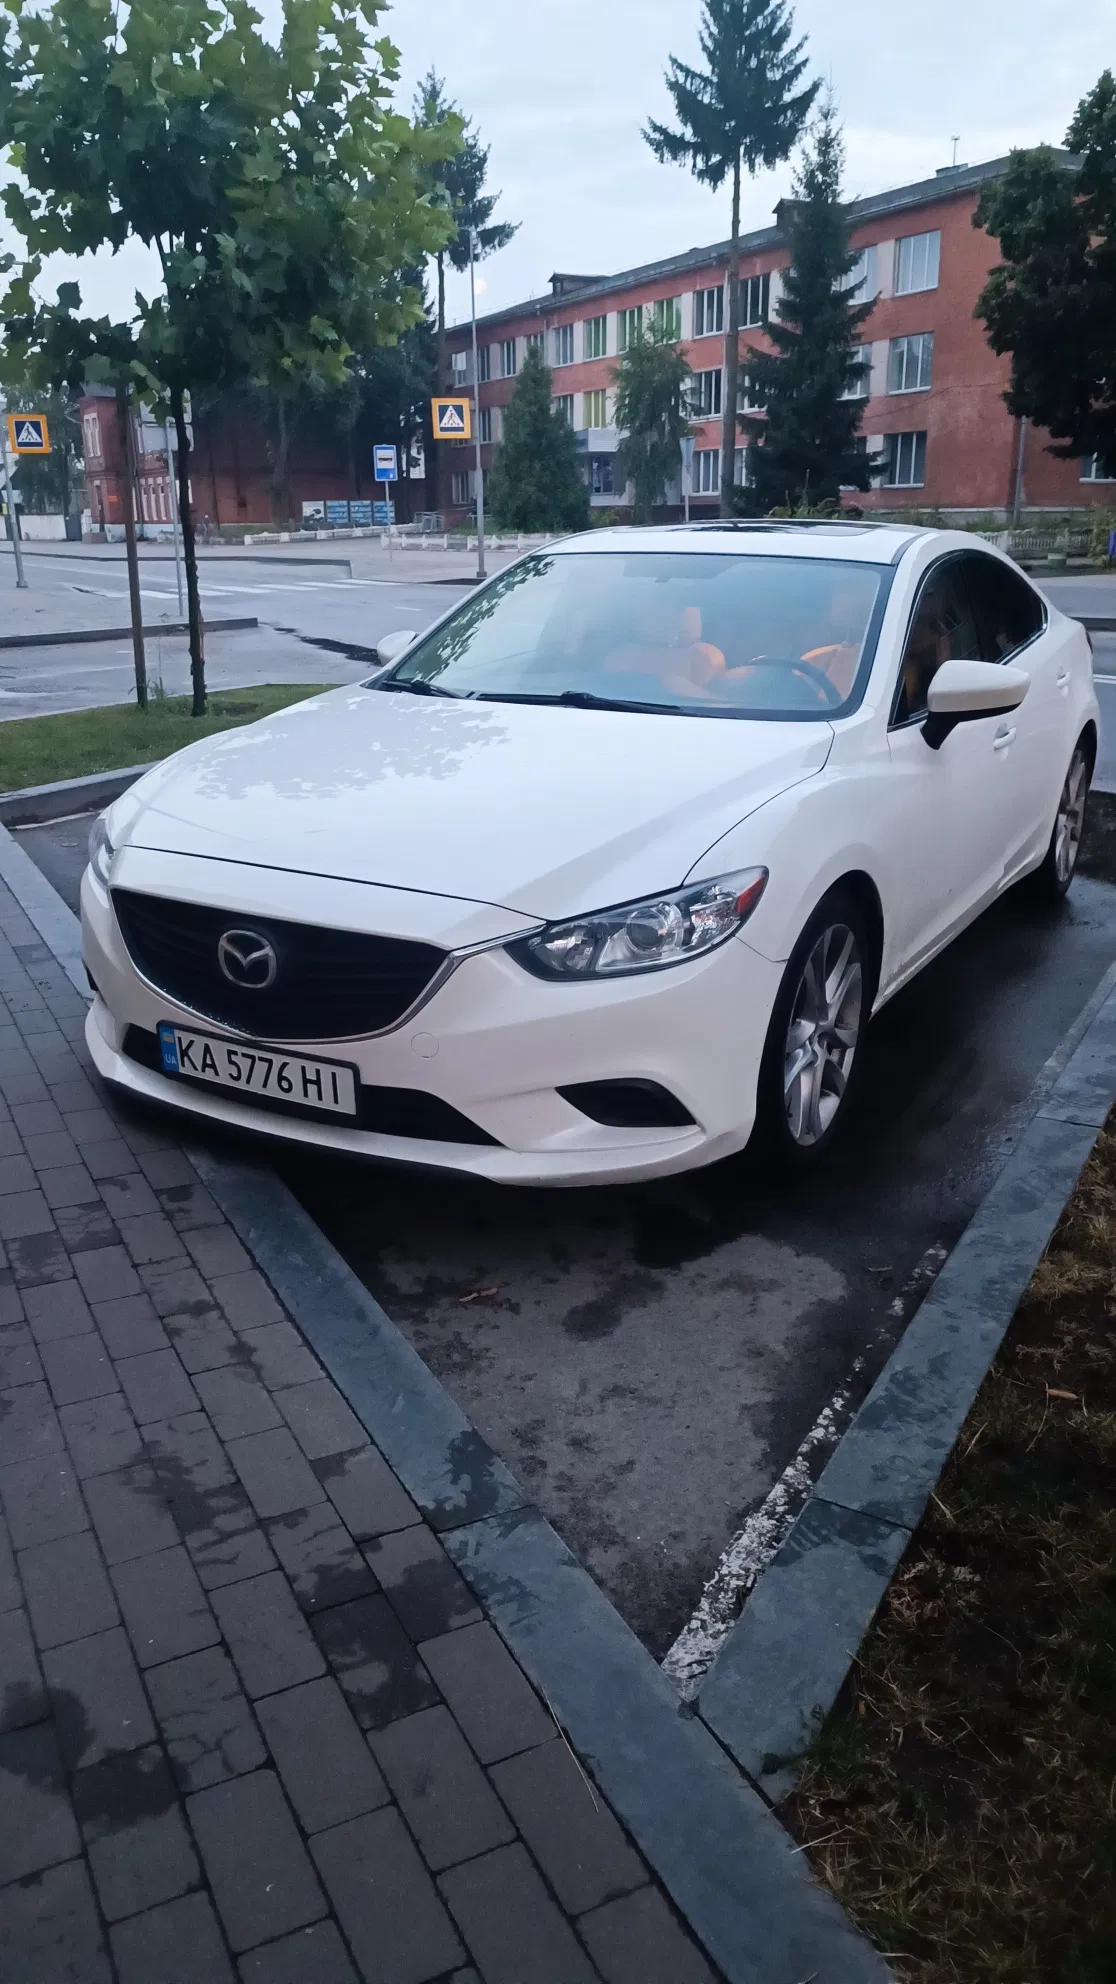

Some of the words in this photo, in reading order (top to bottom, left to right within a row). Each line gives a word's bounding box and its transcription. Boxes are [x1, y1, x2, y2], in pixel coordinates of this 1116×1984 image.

[164, 1053, 177, 1065] UA
[177, 1036, 220, 1077] KA
[226, 1048, 293, 1093] 5776
[301, 1065, 339, 1105] HI
